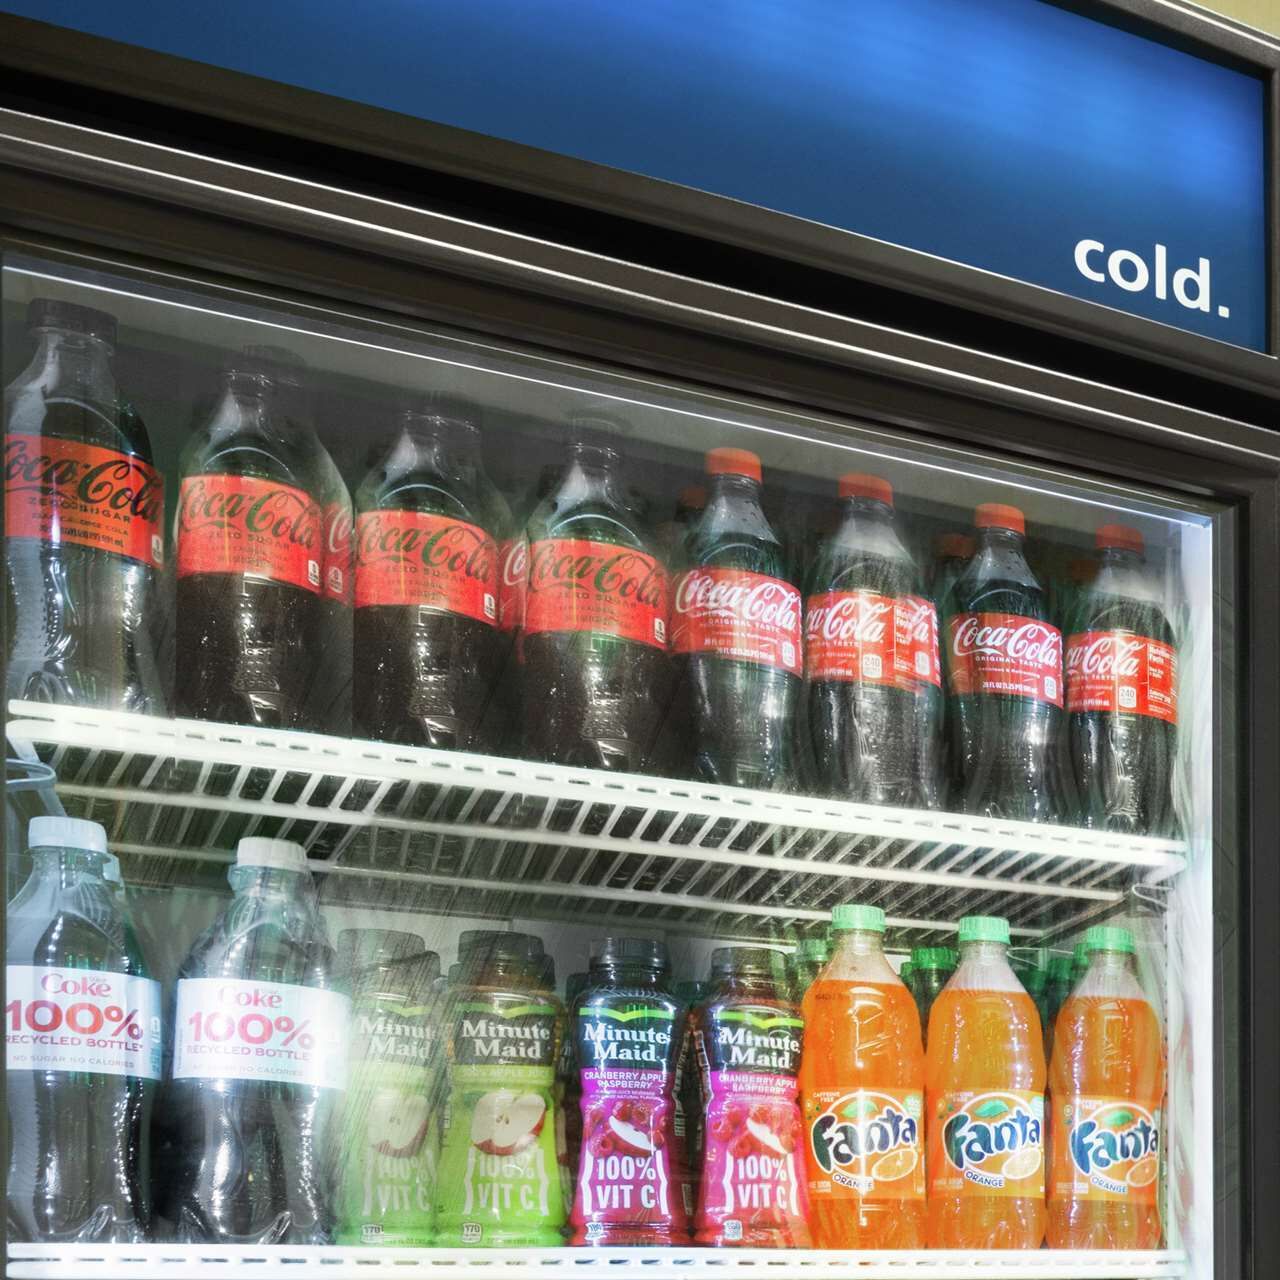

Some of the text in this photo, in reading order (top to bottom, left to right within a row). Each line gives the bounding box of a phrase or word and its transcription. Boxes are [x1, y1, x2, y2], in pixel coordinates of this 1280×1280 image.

[1073, 239, 1230, 317] cold.
[953, 617, 1058, 667] Coca-Cola
[42, 973, 112, 998] Coke
[6, 1000, 144, 1039] 100%
[188, 1012, 316, 1049] 100%
[462, 1017, 550, 1041] Minute
[585, 1024, 668, 1045] Minute
[721, 1028, 800, 1051] Minute
[473, 1038, 542, 1059] Maid
[594, 1042, 658, 1061] Maid
[730, 1047, 791, 1068] Maid
[812, 1108, 917, 1167] Fanta
[945, 1108, 1042, 1166] Fanta
[1072, 1119, 1158, 1175] Fanta
[597, 1157, 656, 1180] 100%
[964, 1170, 1005, 1187] ORANGE
[598, 1184, 657, 1208] VIT C
